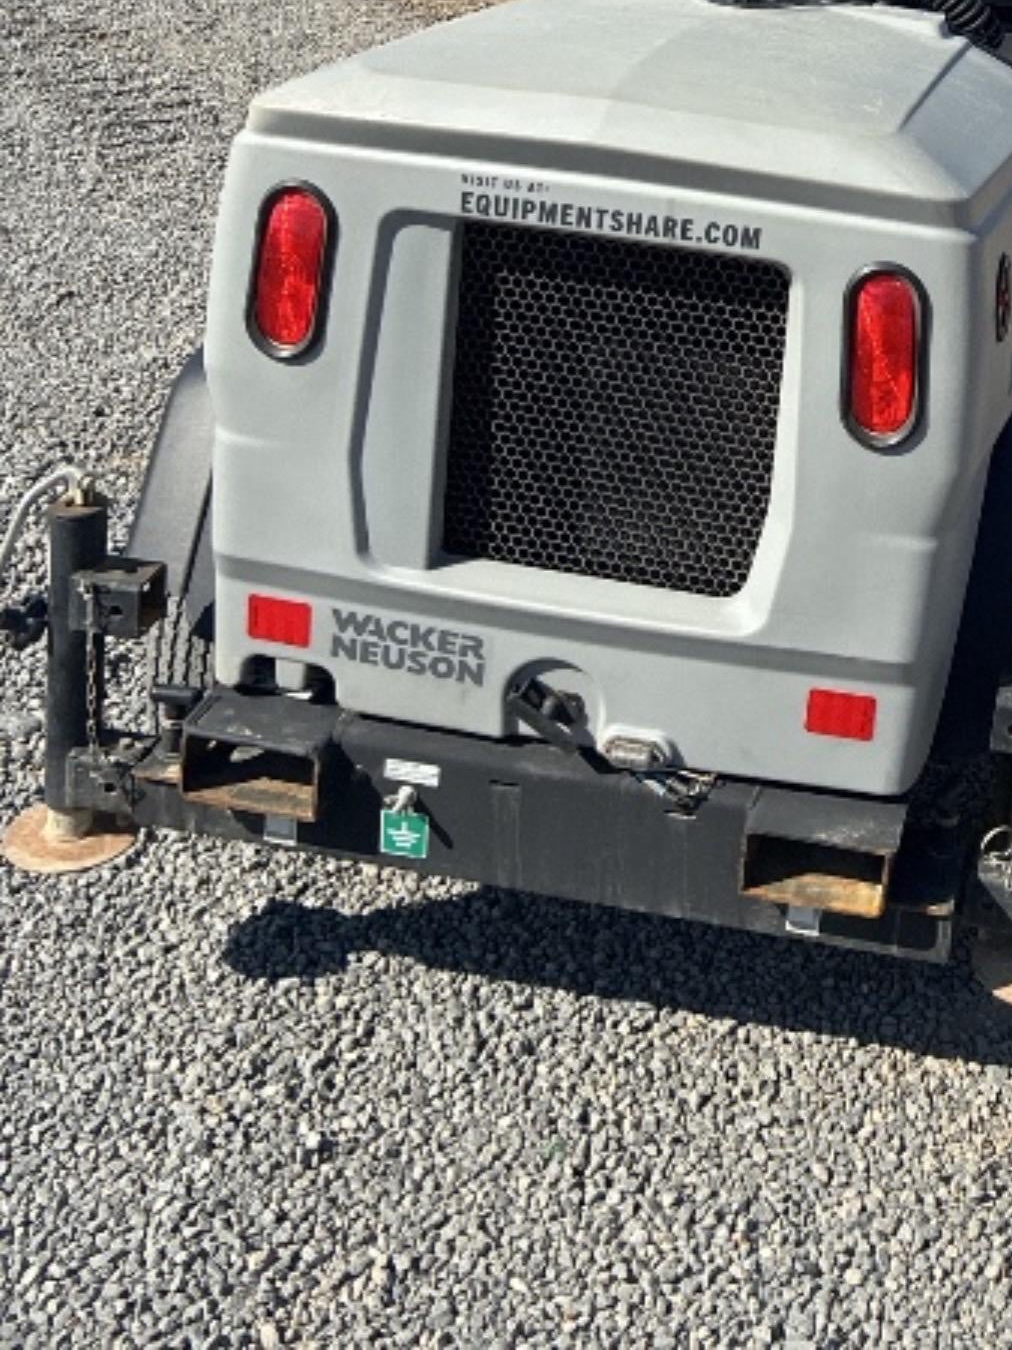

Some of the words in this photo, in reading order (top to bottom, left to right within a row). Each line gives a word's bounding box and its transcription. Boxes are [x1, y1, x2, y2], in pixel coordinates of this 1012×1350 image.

[459, 190, 764, 251] EQUIPMENTSHARE.COM
[330, 633, 486, 688] NEUSON
[331, 607, 486, 661] WACKER
